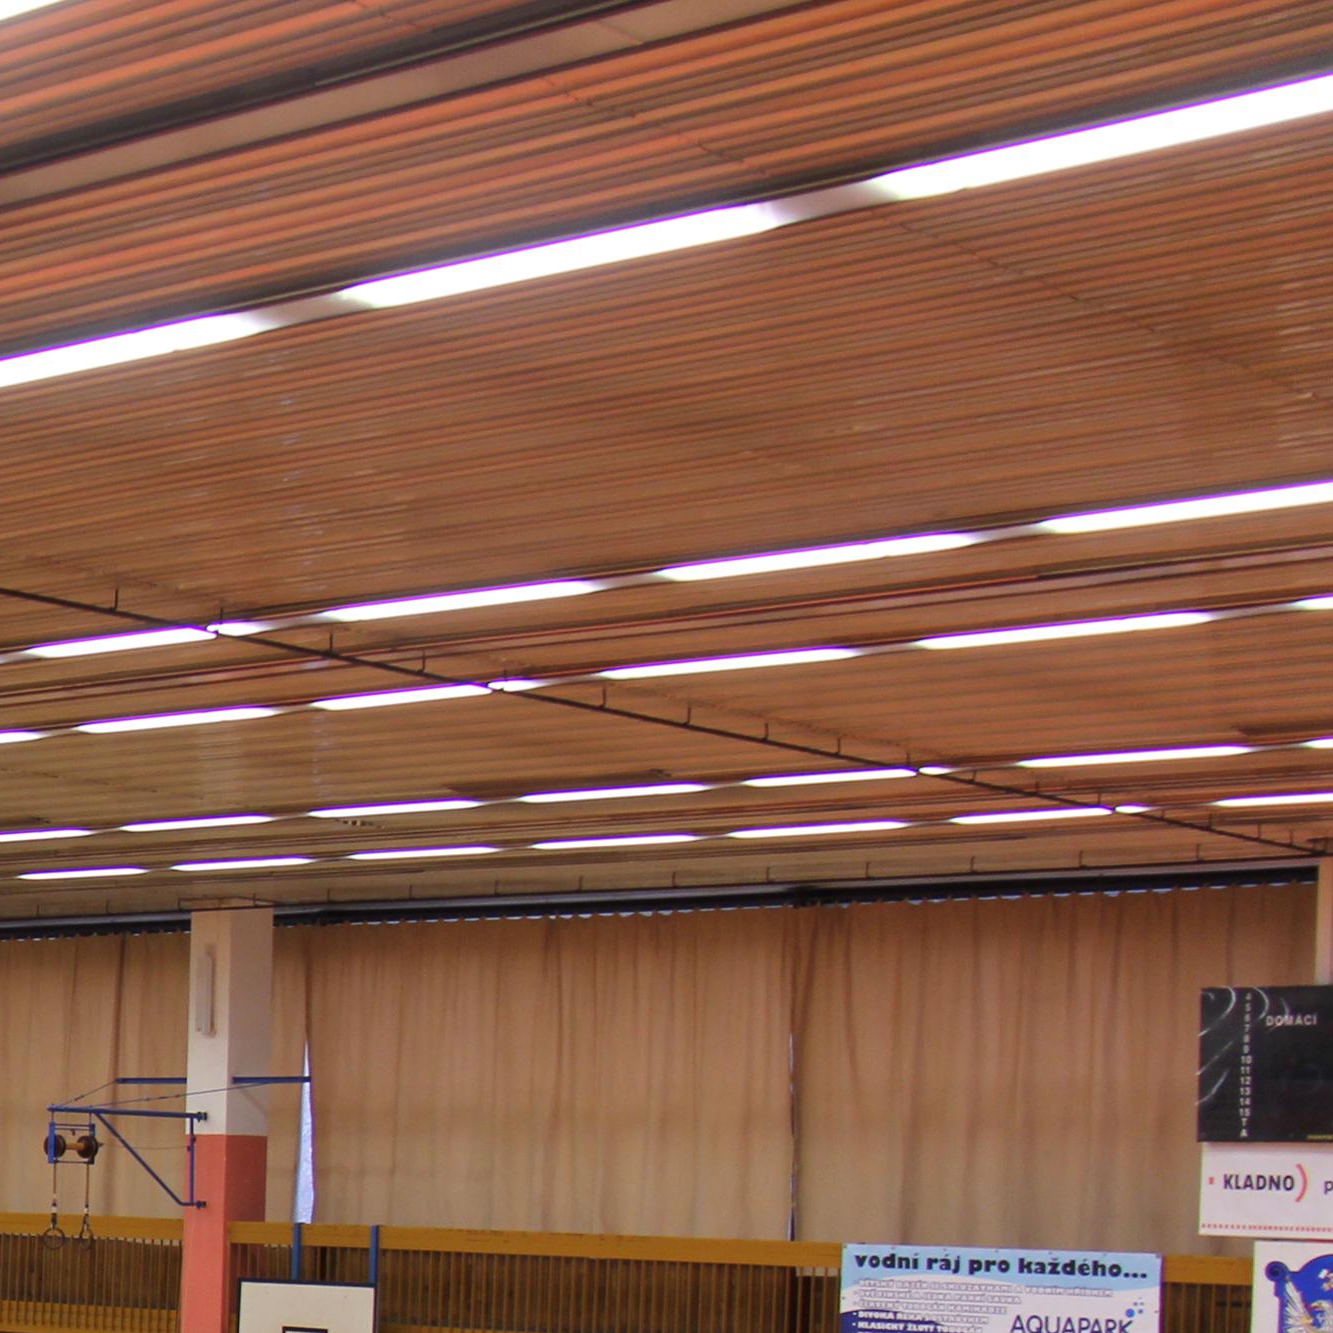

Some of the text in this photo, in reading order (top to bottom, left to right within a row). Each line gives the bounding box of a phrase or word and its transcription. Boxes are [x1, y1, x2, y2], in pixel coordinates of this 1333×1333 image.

[1240, 1066, 1251, 1074] 11
[1240, 1076, 1252, 1085] 12
[1239, 1087, 1251, 1096] 13
[1239, 1097, 1251, 1106] 14
[1239, 1108, 1251, 1117] 15
[1222, 1174, 1296, 1192] KLADNO
[854, 1252, 1148, 1278] vodní ráj pro každého...
